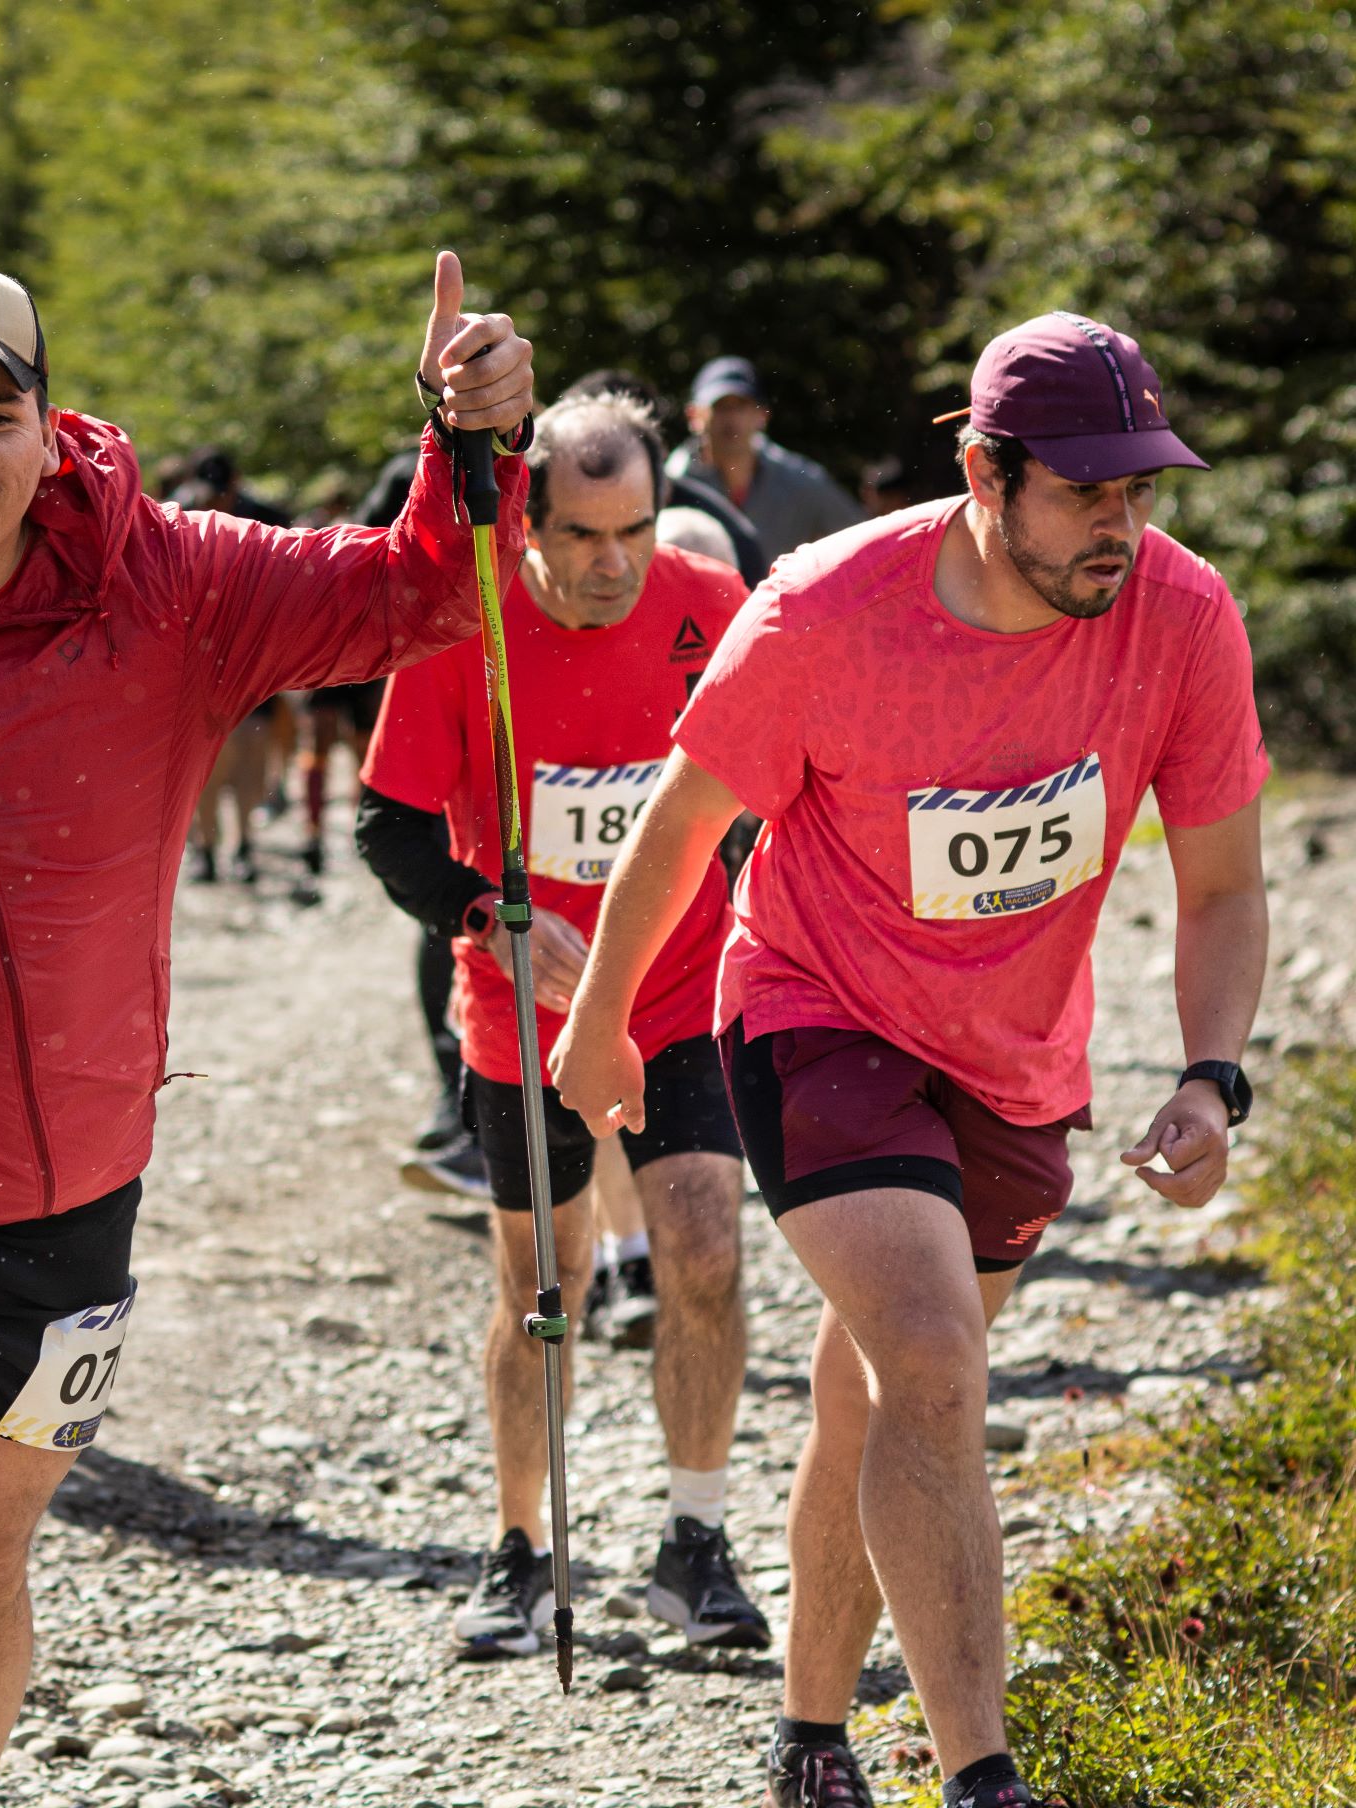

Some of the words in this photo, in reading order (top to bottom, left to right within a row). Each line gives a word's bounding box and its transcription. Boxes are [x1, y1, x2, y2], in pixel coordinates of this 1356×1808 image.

[496, 640, 505, 686] OUTDOOR
[948, 812, 1073, 877] 075
[60, 1344, 121, 1405] 07
